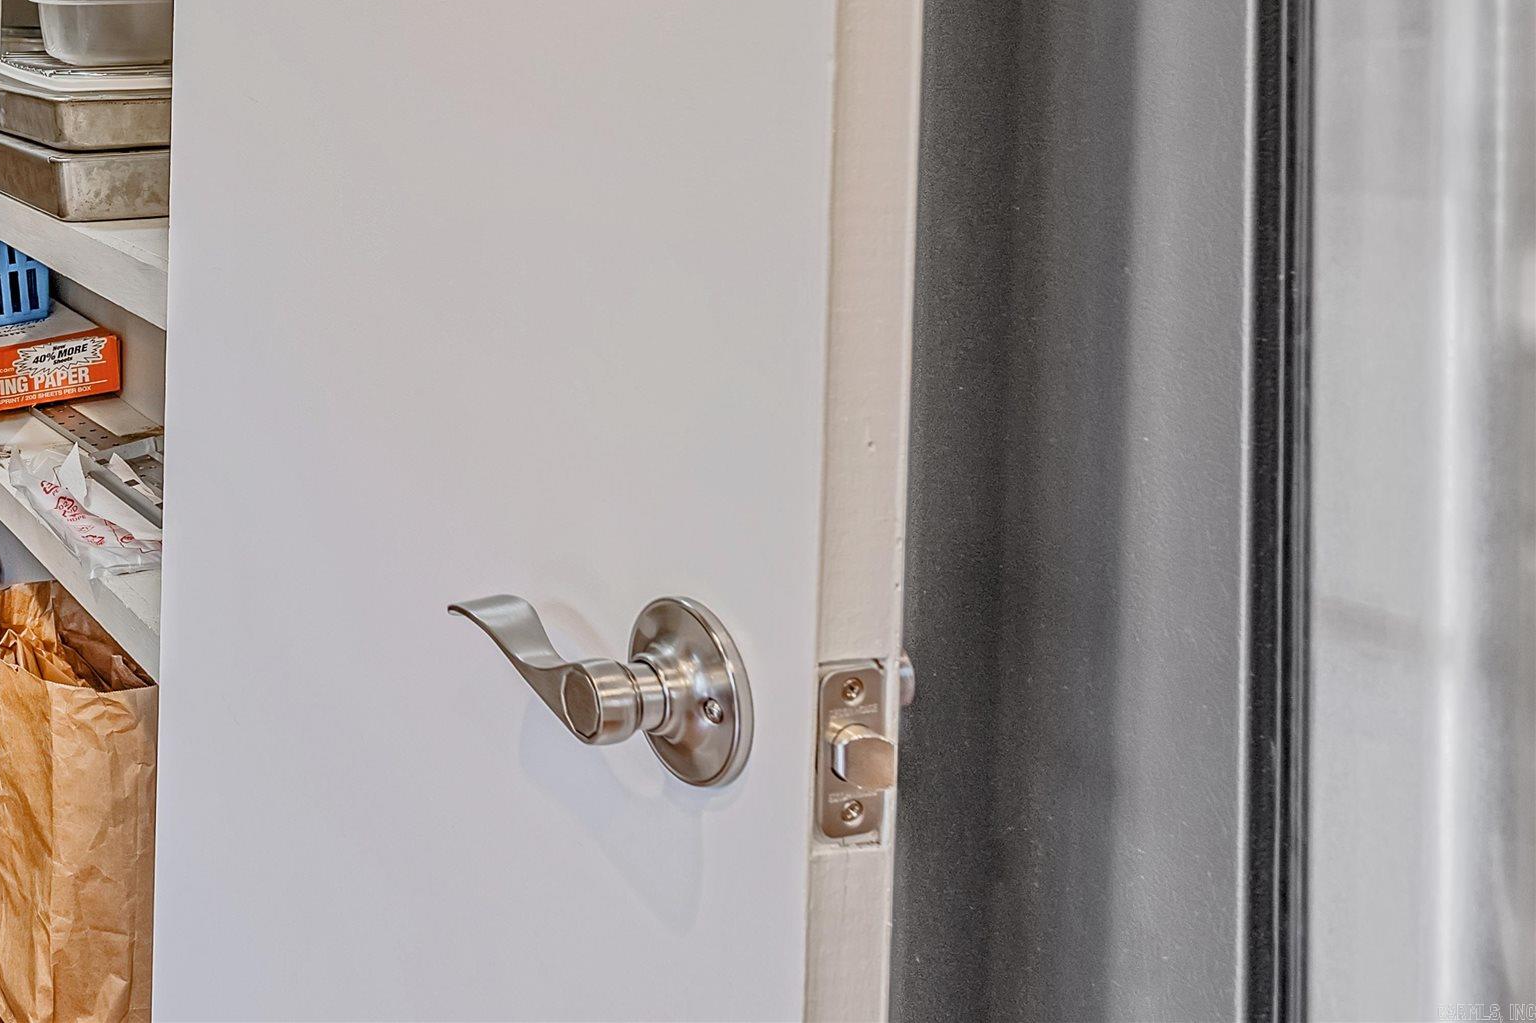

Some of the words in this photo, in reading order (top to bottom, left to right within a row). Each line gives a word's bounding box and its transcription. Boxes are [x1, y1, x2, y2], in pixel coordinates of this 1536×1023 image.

[32, 352, 56, 364] 40%
[57, 343, 88, 359] MORE
[53, 357, 72, 365] Sheets
[33, 367, 90, 390] PAPER
[37, 390, 63, 398] SHEETS
